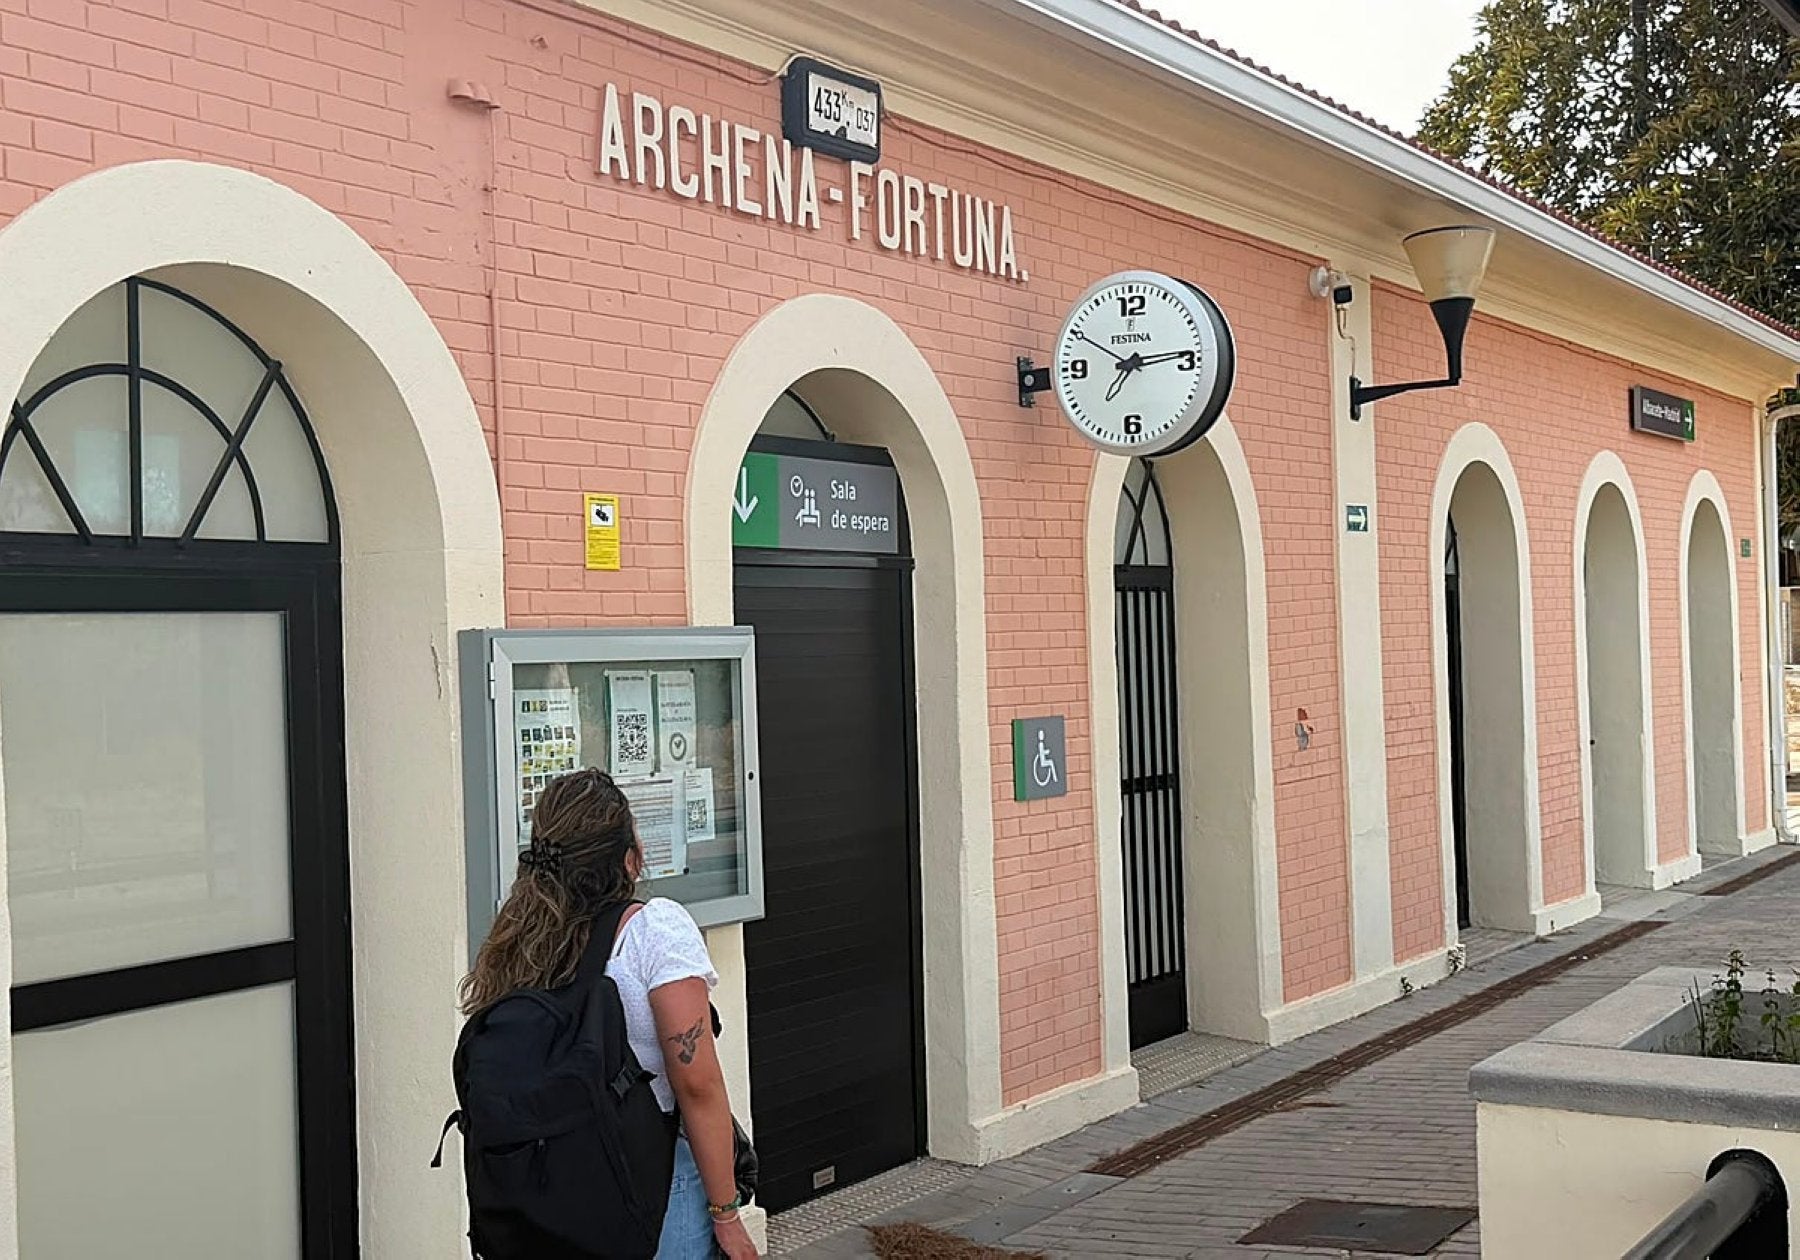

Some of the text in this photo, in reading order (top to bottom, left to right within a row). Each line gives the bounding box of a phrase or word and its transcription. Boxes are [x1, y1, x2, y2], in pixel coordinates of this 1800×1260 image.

[1116, 295, 1146, 317] 12
[1111, 333, 1151, 344] FESTINA
[1070, 350, 1195, 379] 9 3
[1123, 414, 1142, 435] 6
[831, 480, 856, 500] Sala
[832, 509, 888, 533] de espera
